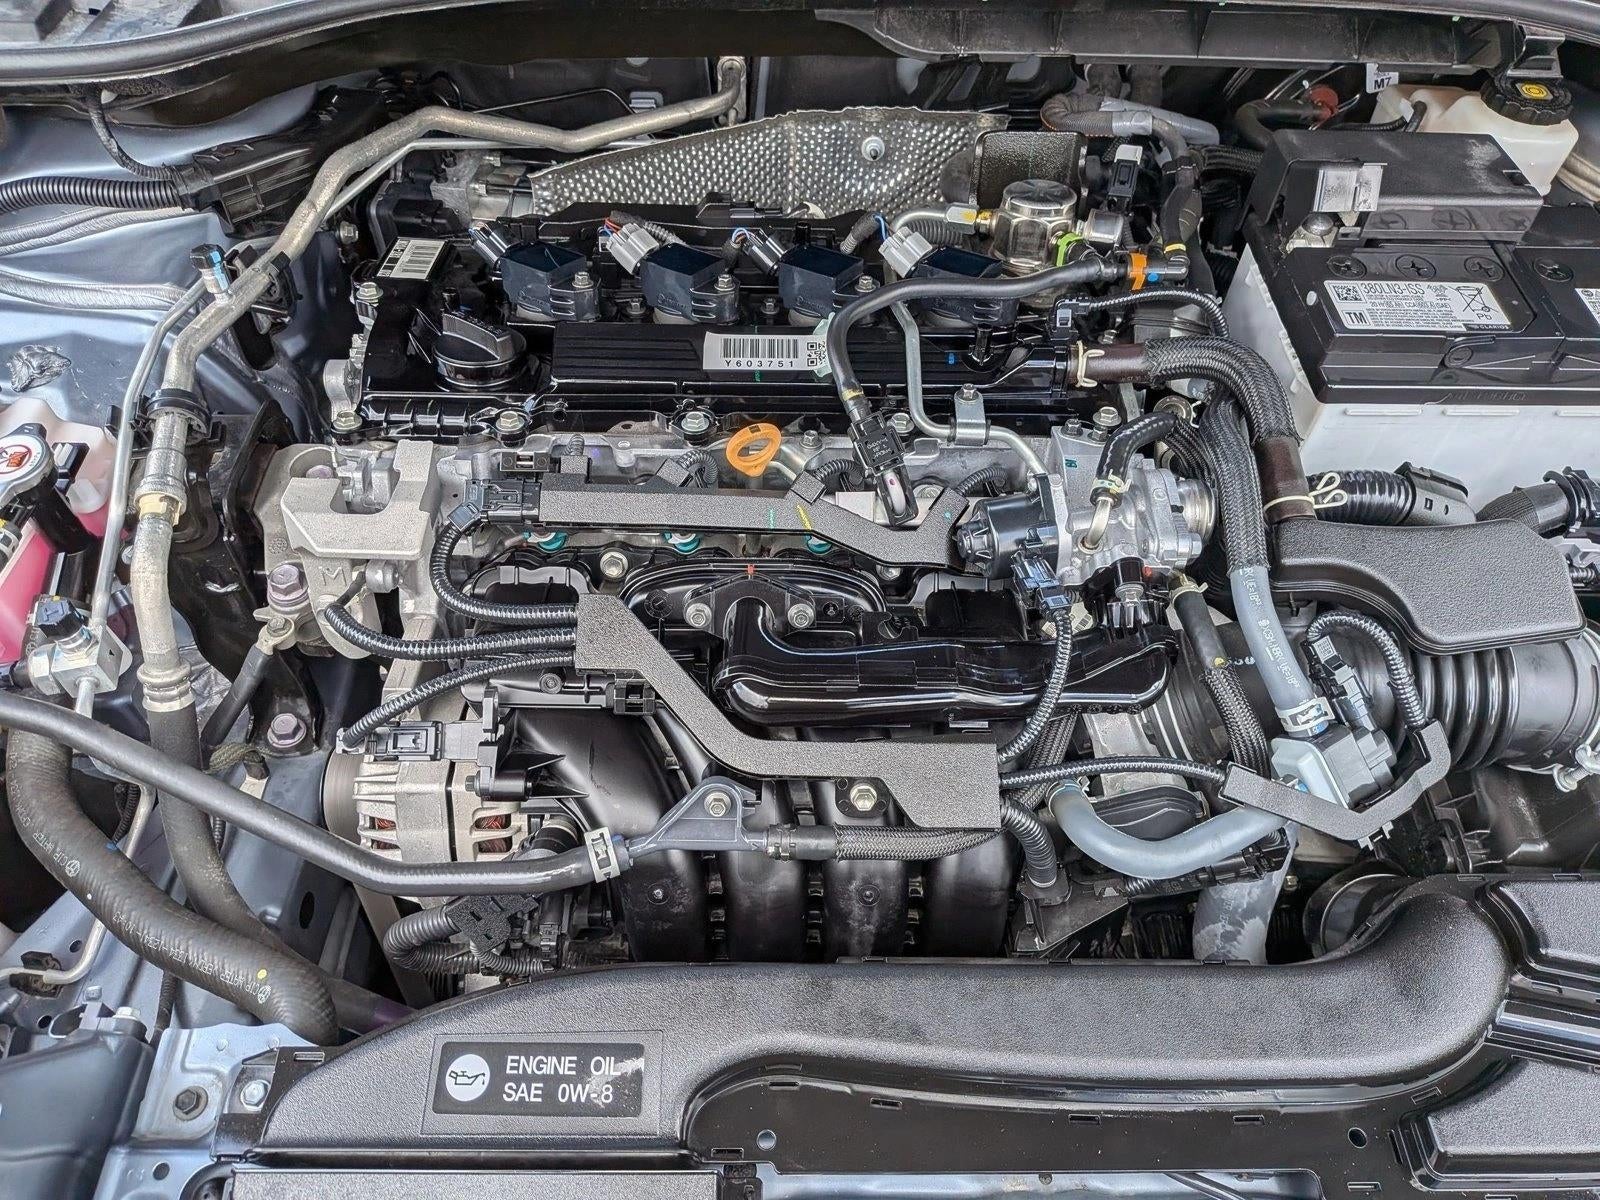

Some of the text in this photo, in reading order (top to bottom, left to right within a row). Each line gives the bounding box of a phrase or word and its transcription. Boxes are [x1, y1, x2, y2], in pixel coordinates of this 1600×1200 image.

[1361, 282, 1425, 295] 380LN3-ISS
[1345, 311, 1368, 324] TM
[1476, 312, 1492, 321] Pb
[725, 360, 794, 368] Y603751
[506, 1055, 621, 1076] ENGINE OIL
[502, 1082, 614, 1103] SAE 0W-8
